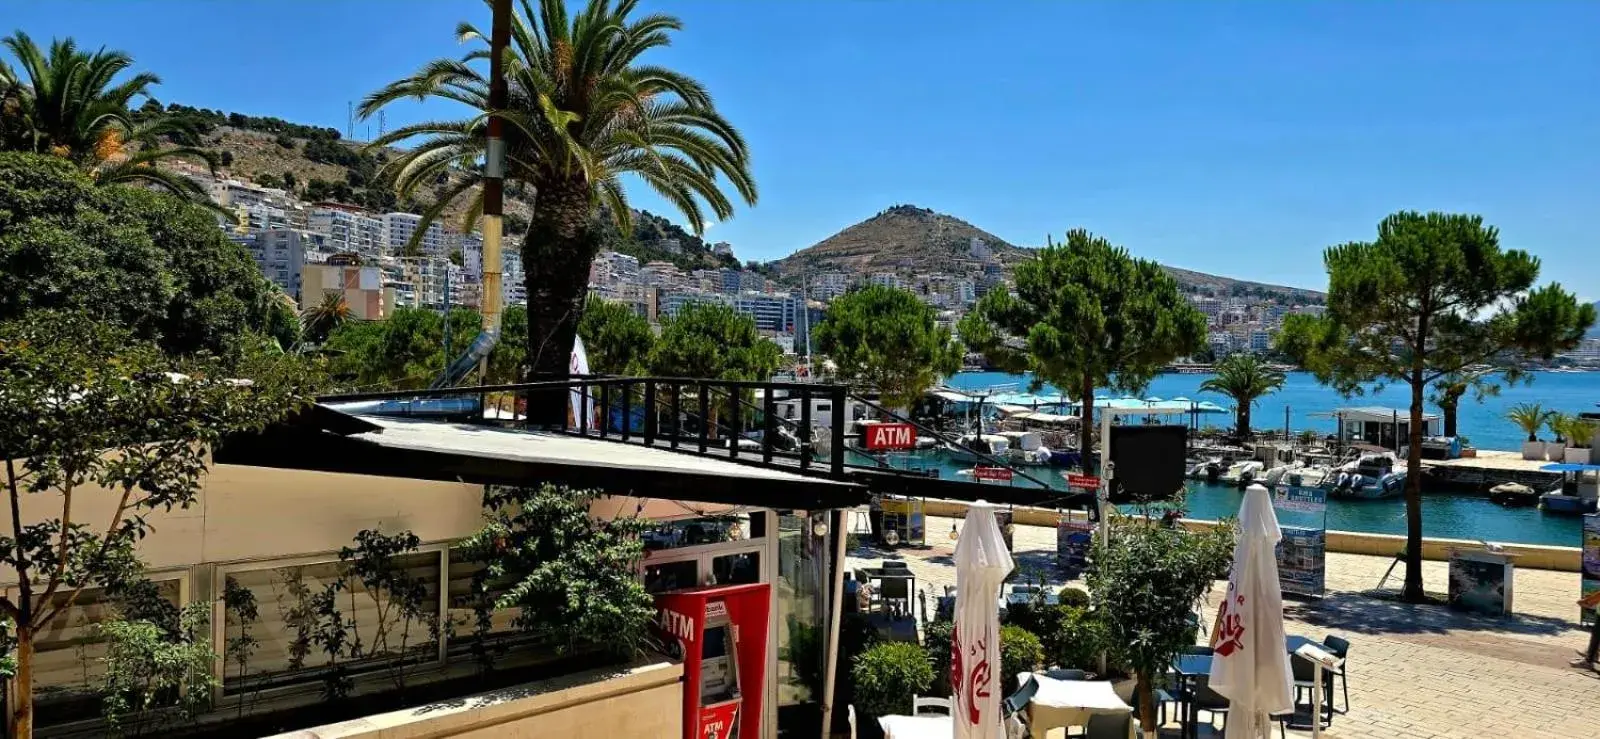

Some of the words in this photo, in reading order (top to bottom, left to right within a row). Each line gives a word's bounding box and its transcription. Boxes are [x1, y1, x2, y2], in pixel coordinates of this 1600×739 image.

[874, 426, 911, 446] ATM
[660, 608, 694, 642] ATM
[704, 720, 723, 734] ATM
